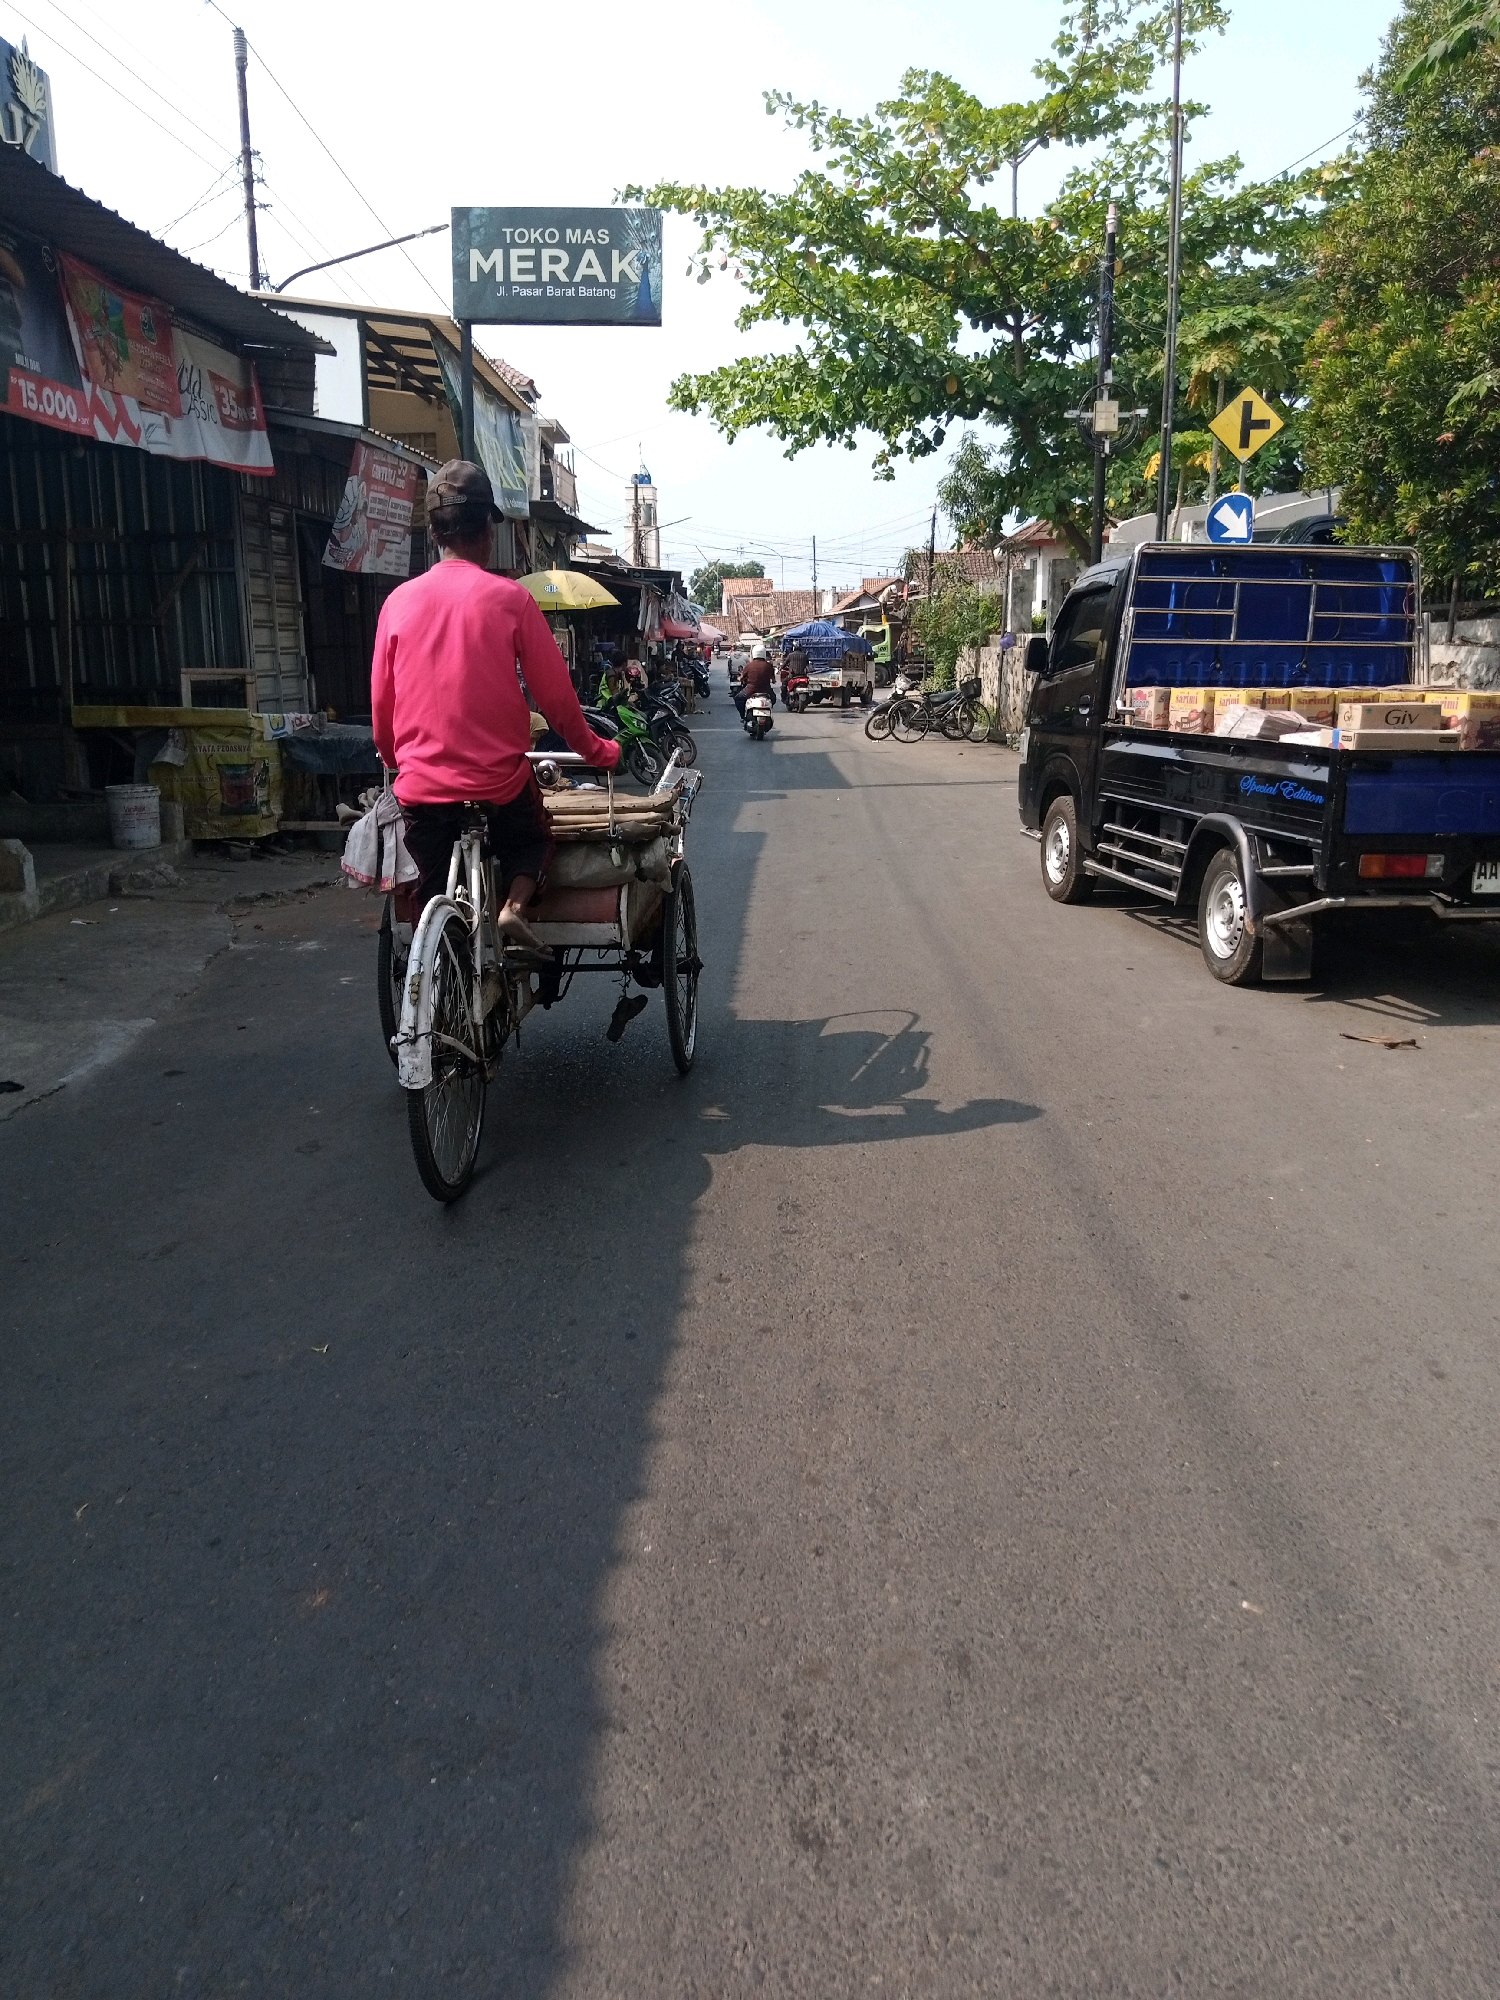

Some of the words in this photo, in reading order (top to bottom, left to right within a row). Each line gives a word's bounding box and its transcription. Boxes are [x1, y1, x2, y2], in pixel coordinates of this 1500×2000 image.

[502, 227, 560, 244] TOKO
[565, 228, 610, 245] MAS
[469, 248, 642, 283] MERAK
[496, 286, 508, 297] Jl.
[512, 286, 543, 297] Pasar
[546, 286, 575, 297] Barat
[579, 286, 616, 300] Batang
[18, 378, 78, 423] 15.000
[1385, 709, 1420, 725] Giv
[1240, 775, 1280, 797] Special
[1280, 780, 1325, 805] Edition
[1477, 861, 1499, 880] AA
